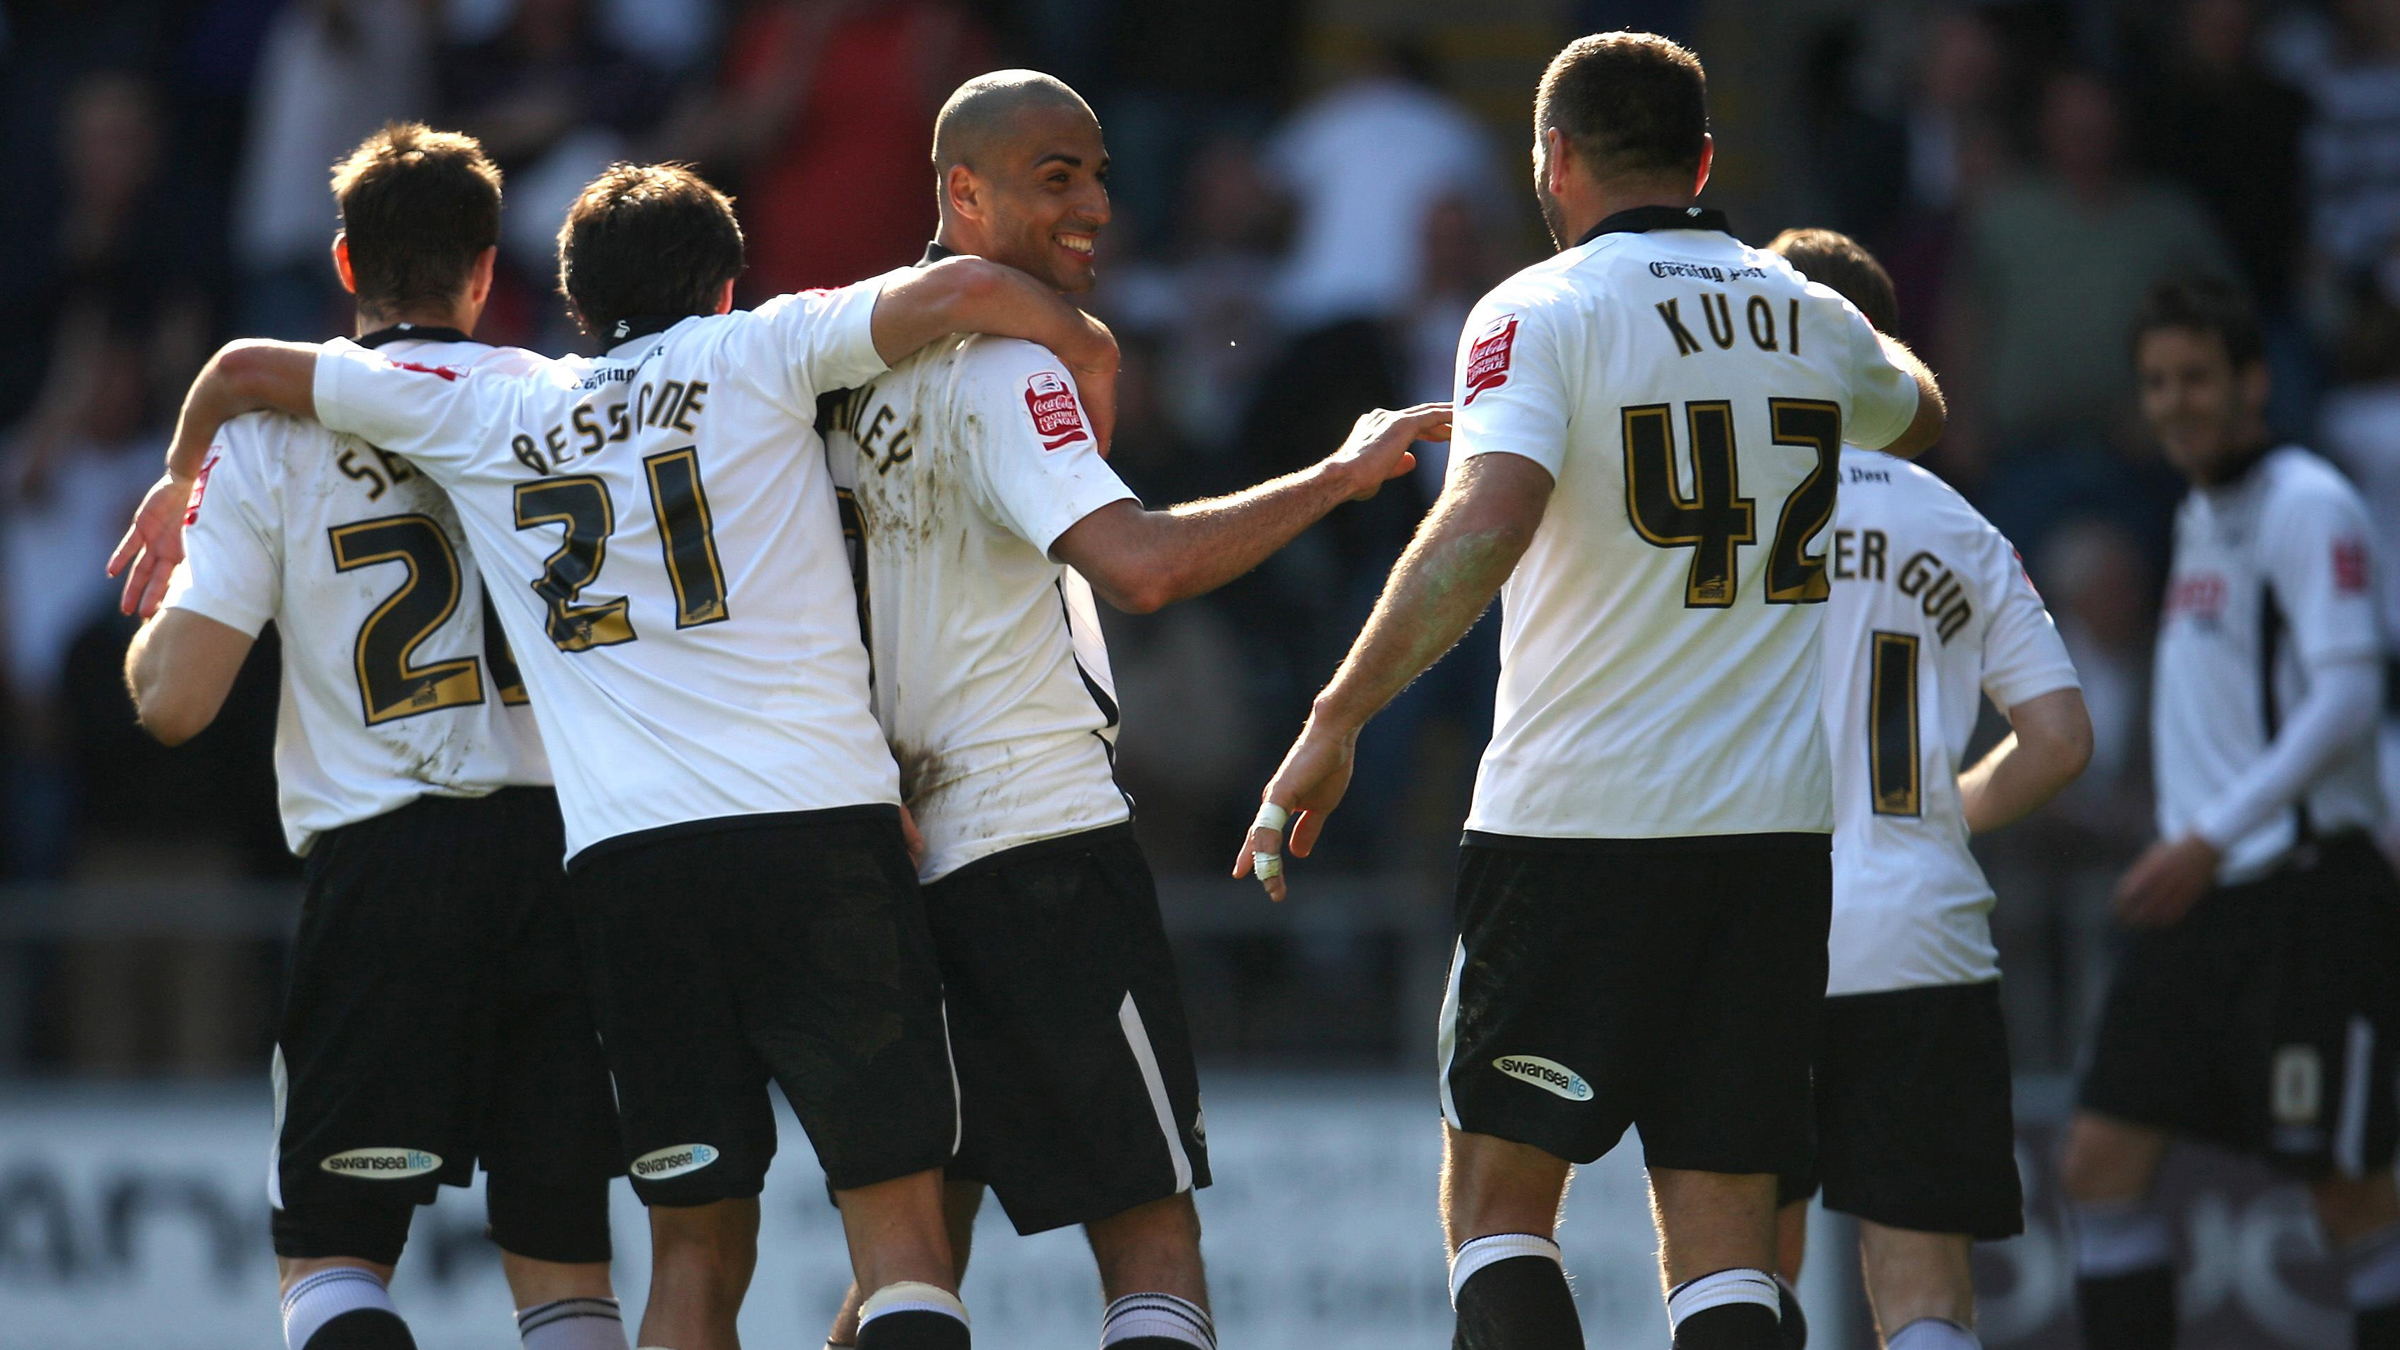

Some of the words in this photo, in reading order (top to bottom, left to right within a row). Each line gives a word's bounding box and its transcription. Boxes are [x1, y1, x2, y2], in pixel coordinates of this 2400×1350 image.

[1655, 293, 1800, 357] KUQI
[1039, 410, 1077, 425] FOOTBALL
[1041, 417, 1081, 432] LEAGUE
[1620, 397, 1842, 608] 42
[513, 445, 730, 653] 21
[1897, 550, 1973, 645] GUN
